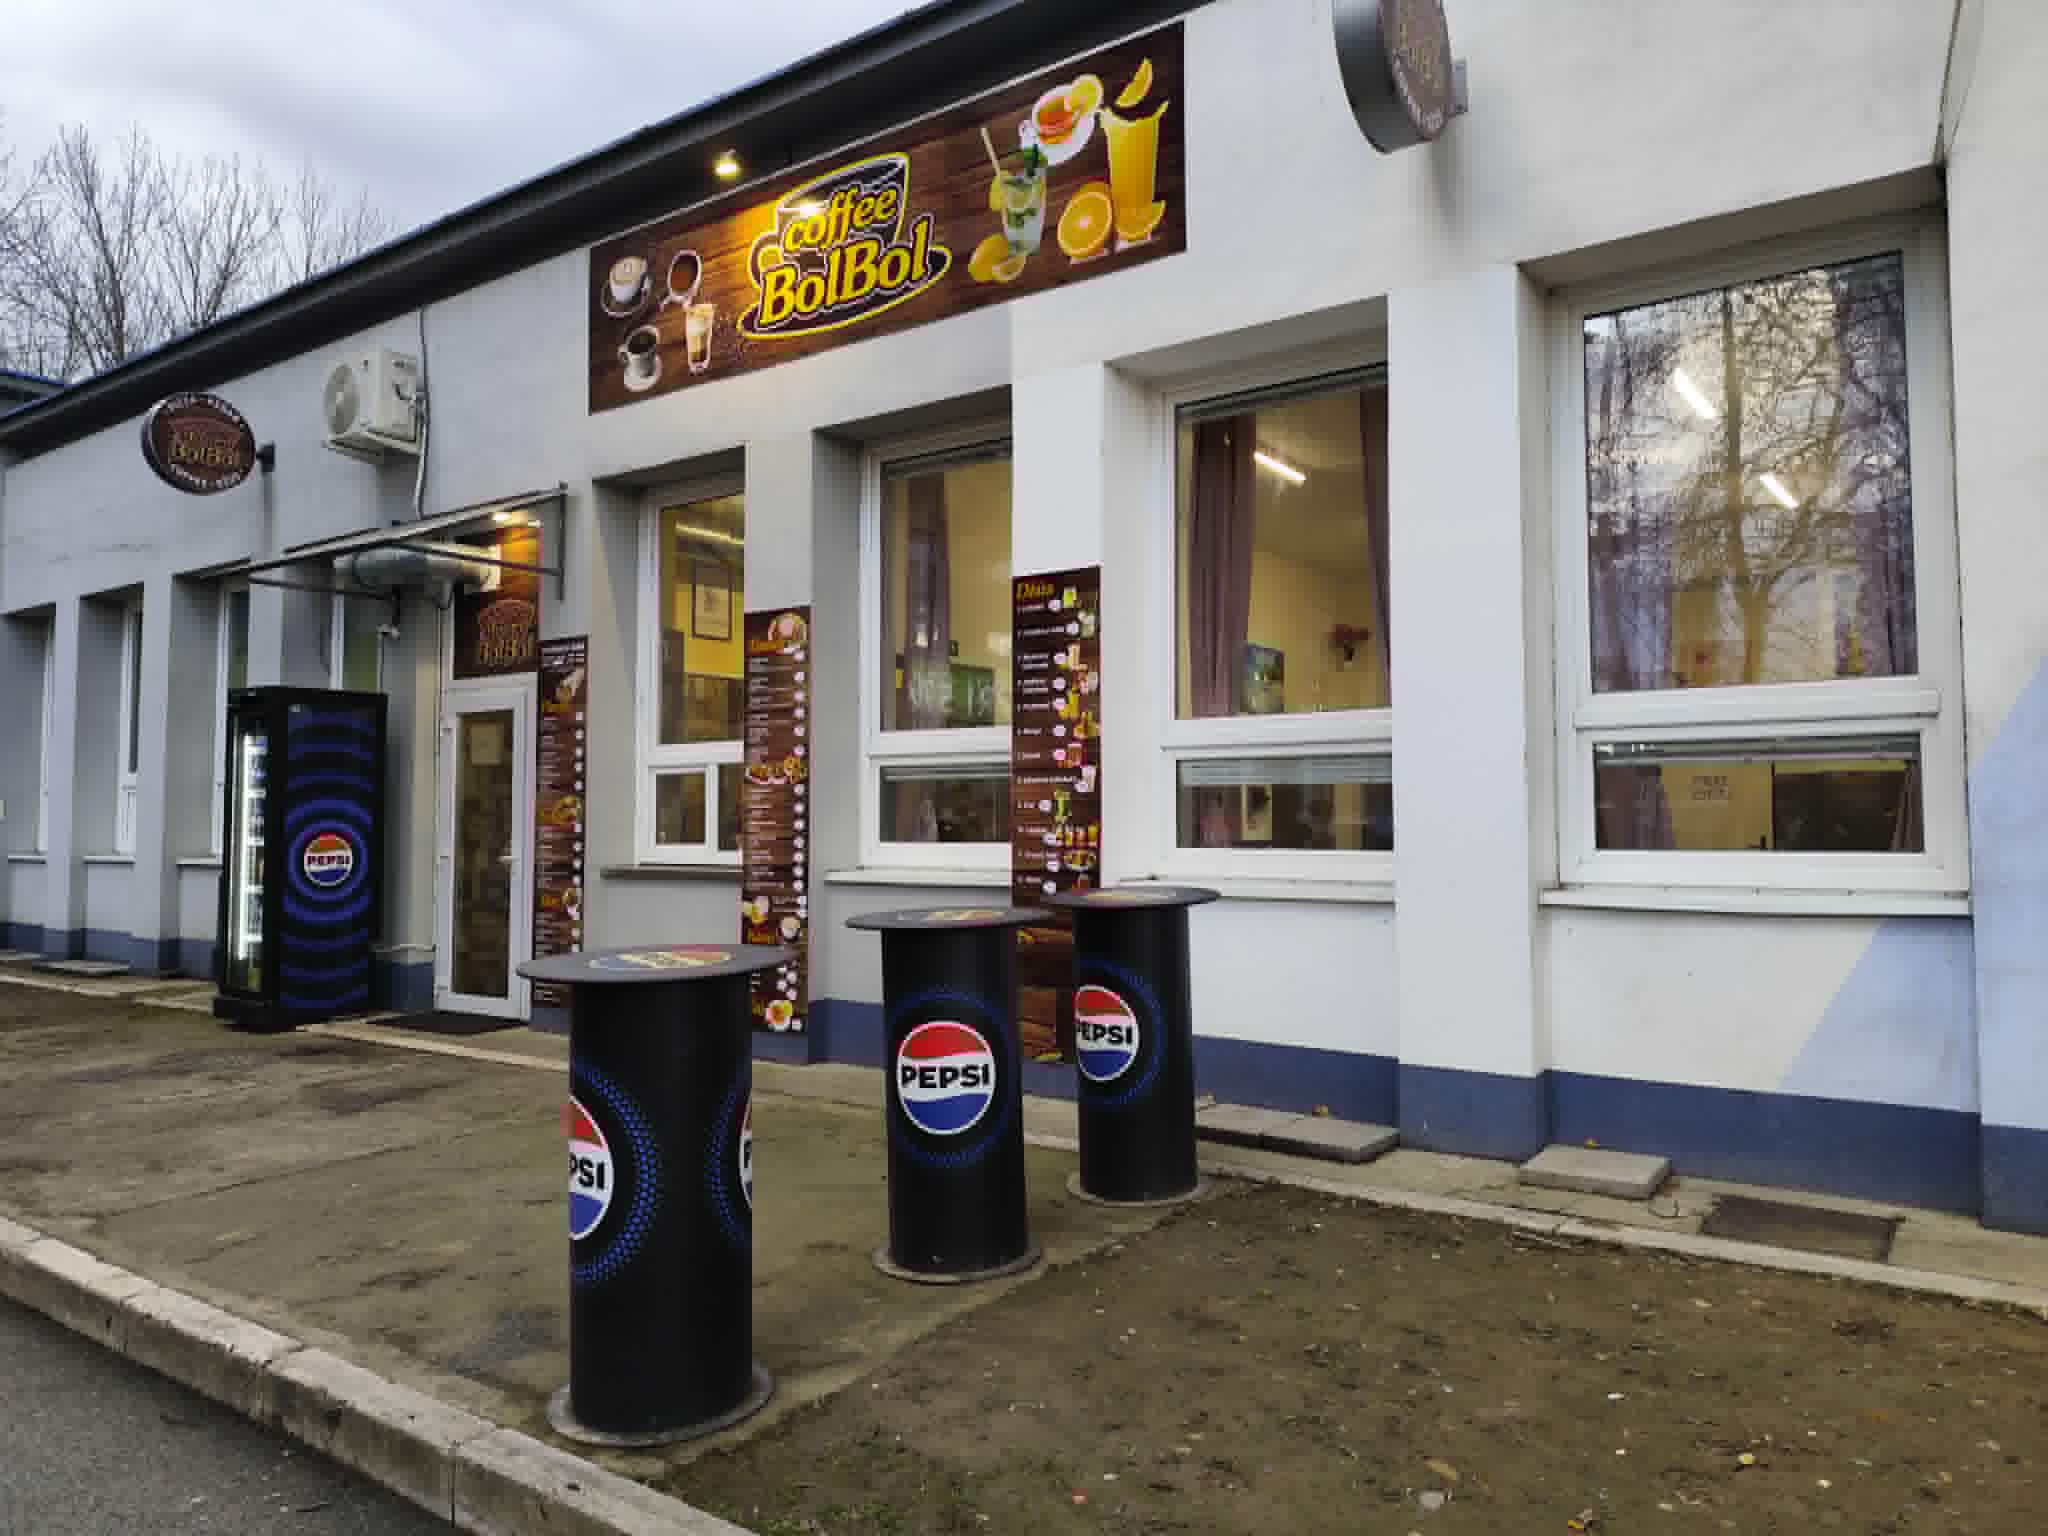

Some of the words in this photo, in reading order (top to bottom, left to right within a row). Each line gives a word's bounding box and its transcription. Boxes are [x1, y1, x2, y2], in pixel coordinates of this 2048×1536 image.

[784, 187, 897, 253] coffee
[760, 220, 929, 326] BolBol
[306, 854, 352, 867] PEPSI
[901, 1063, 990, 1089] PEPSI
